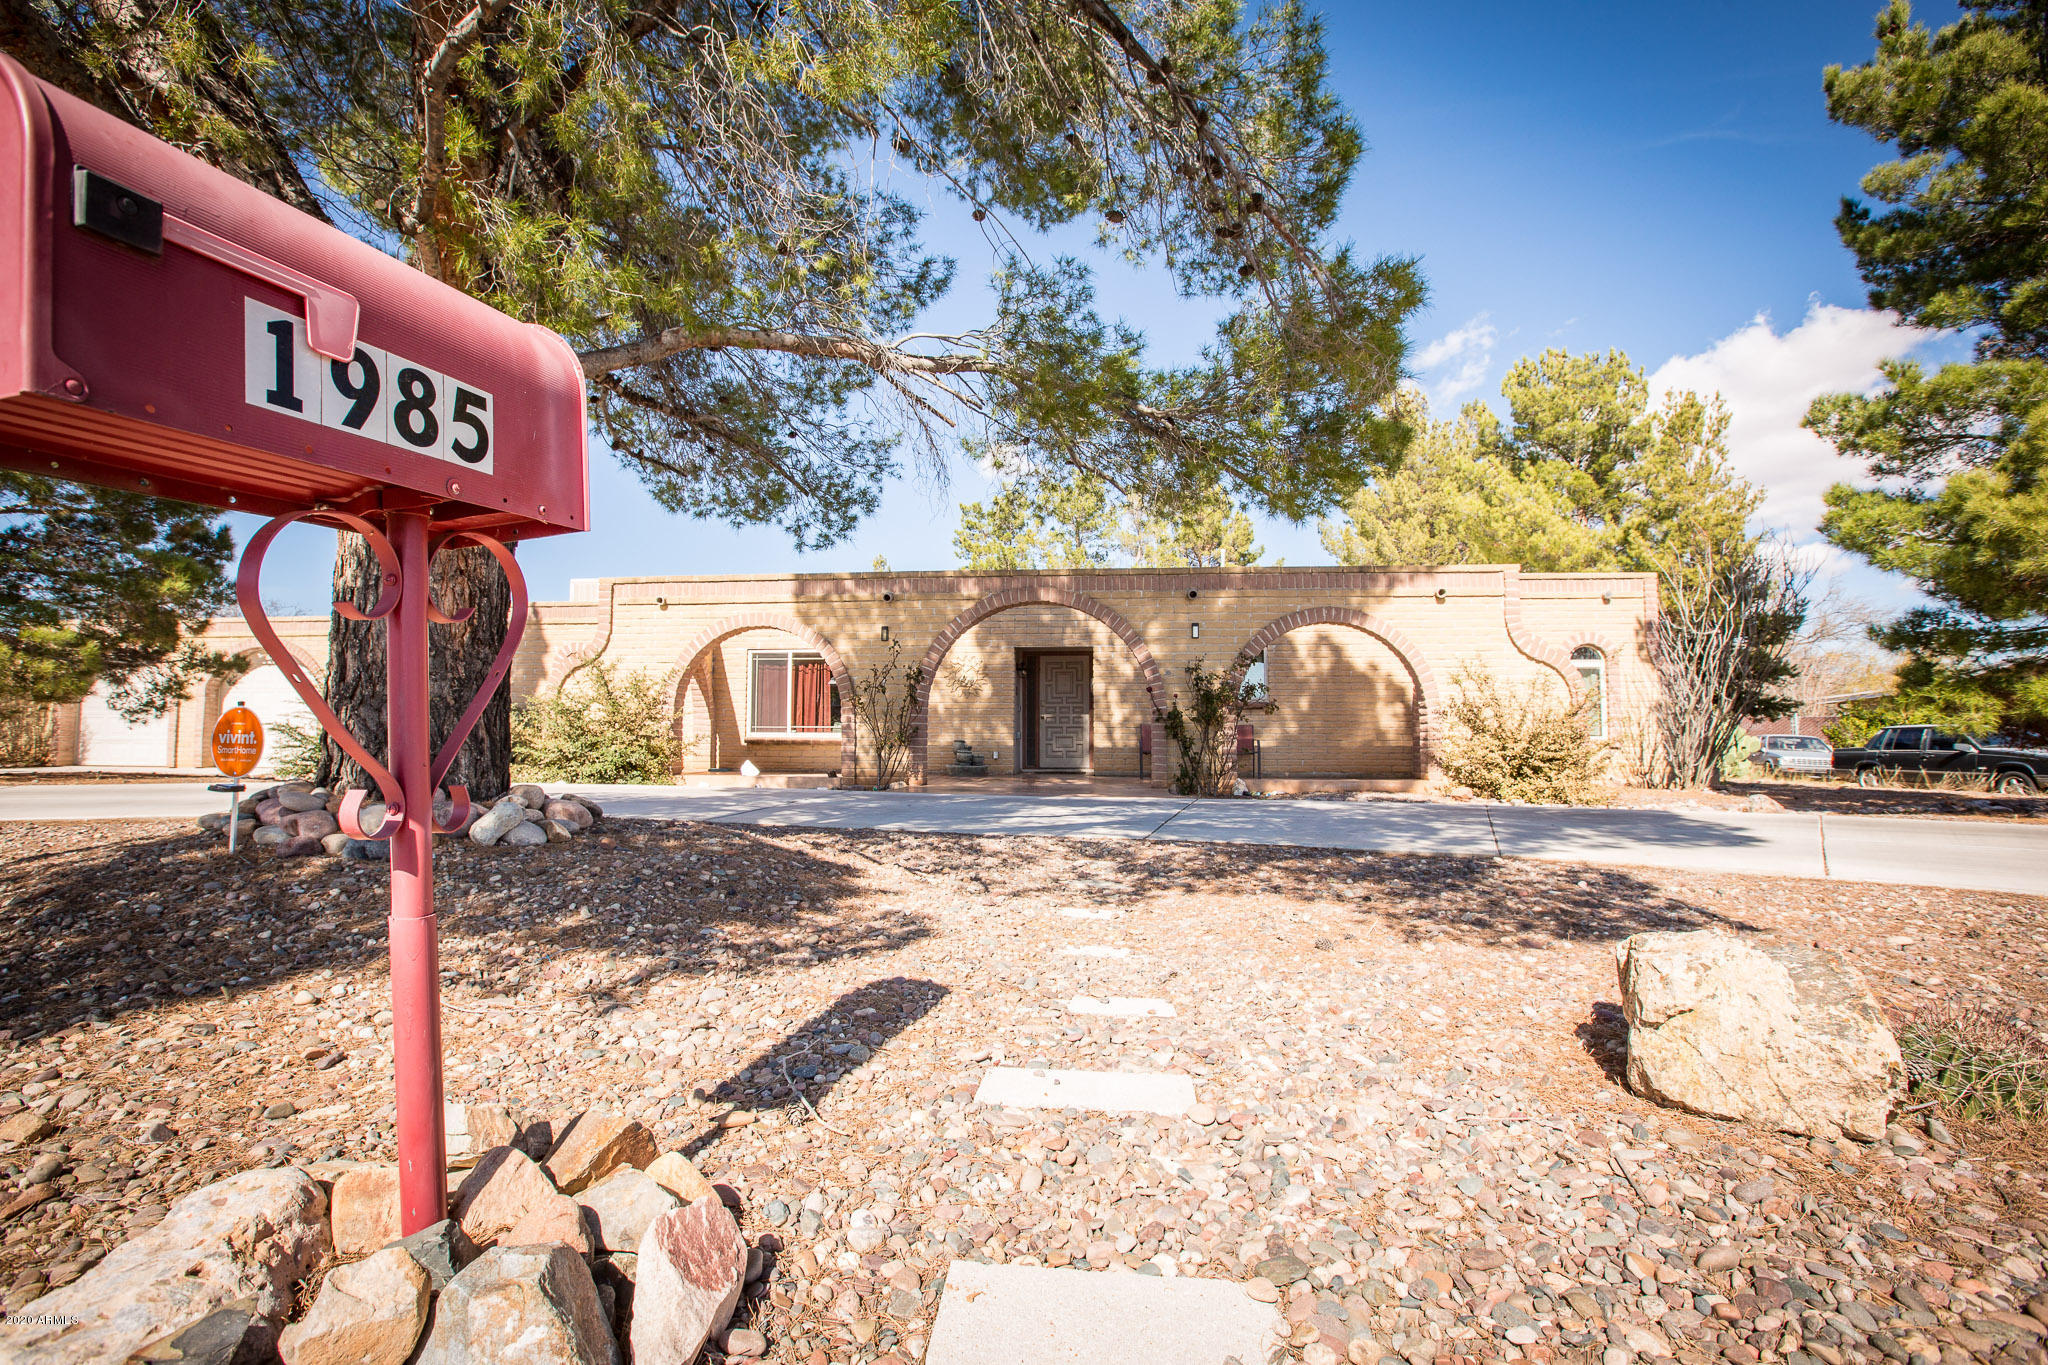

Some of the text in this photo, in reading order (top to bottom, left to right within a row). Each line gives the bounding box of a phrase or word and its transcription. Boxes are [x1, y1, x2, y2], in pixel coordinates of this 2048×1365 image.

[265, 319, 490, 464] 1985
[218, 729, 257, 744] vivint.
[217, 745, 257, 755] SmartHome
